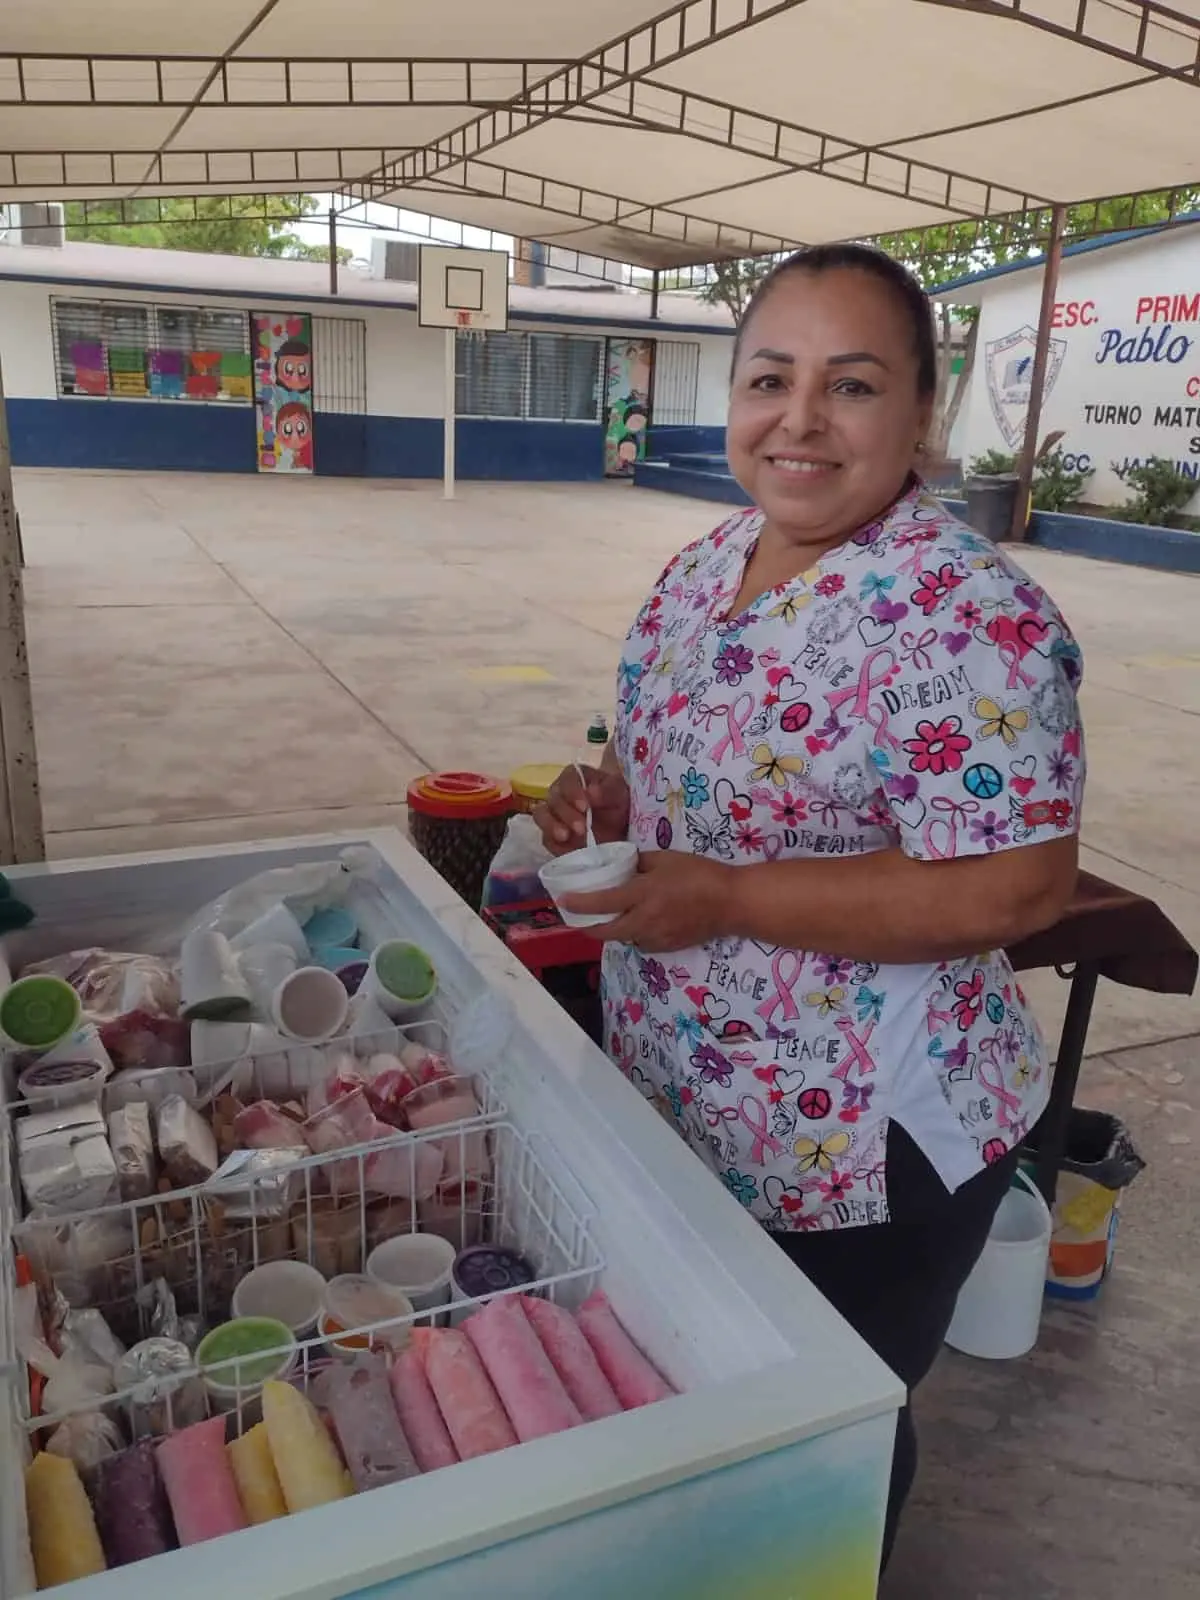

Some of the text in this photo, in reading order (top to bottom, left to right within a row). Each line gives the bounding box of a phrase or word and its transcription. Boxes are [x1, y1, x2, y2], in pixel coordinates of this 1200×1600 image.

[1049, 301, 1099, 328] ESC.
[1095, 324, 1194, 364] Pablo
[1084, 404, 1142, 425] TURNO
[792, 643, 854, 688] PEACE
[881, 665, 975, 715] DREAM
[783, 828, 865, 853] DREAM
[704, 959, 769, 1001] PEACE
[773, 1034, 841, 1064] PEACE
